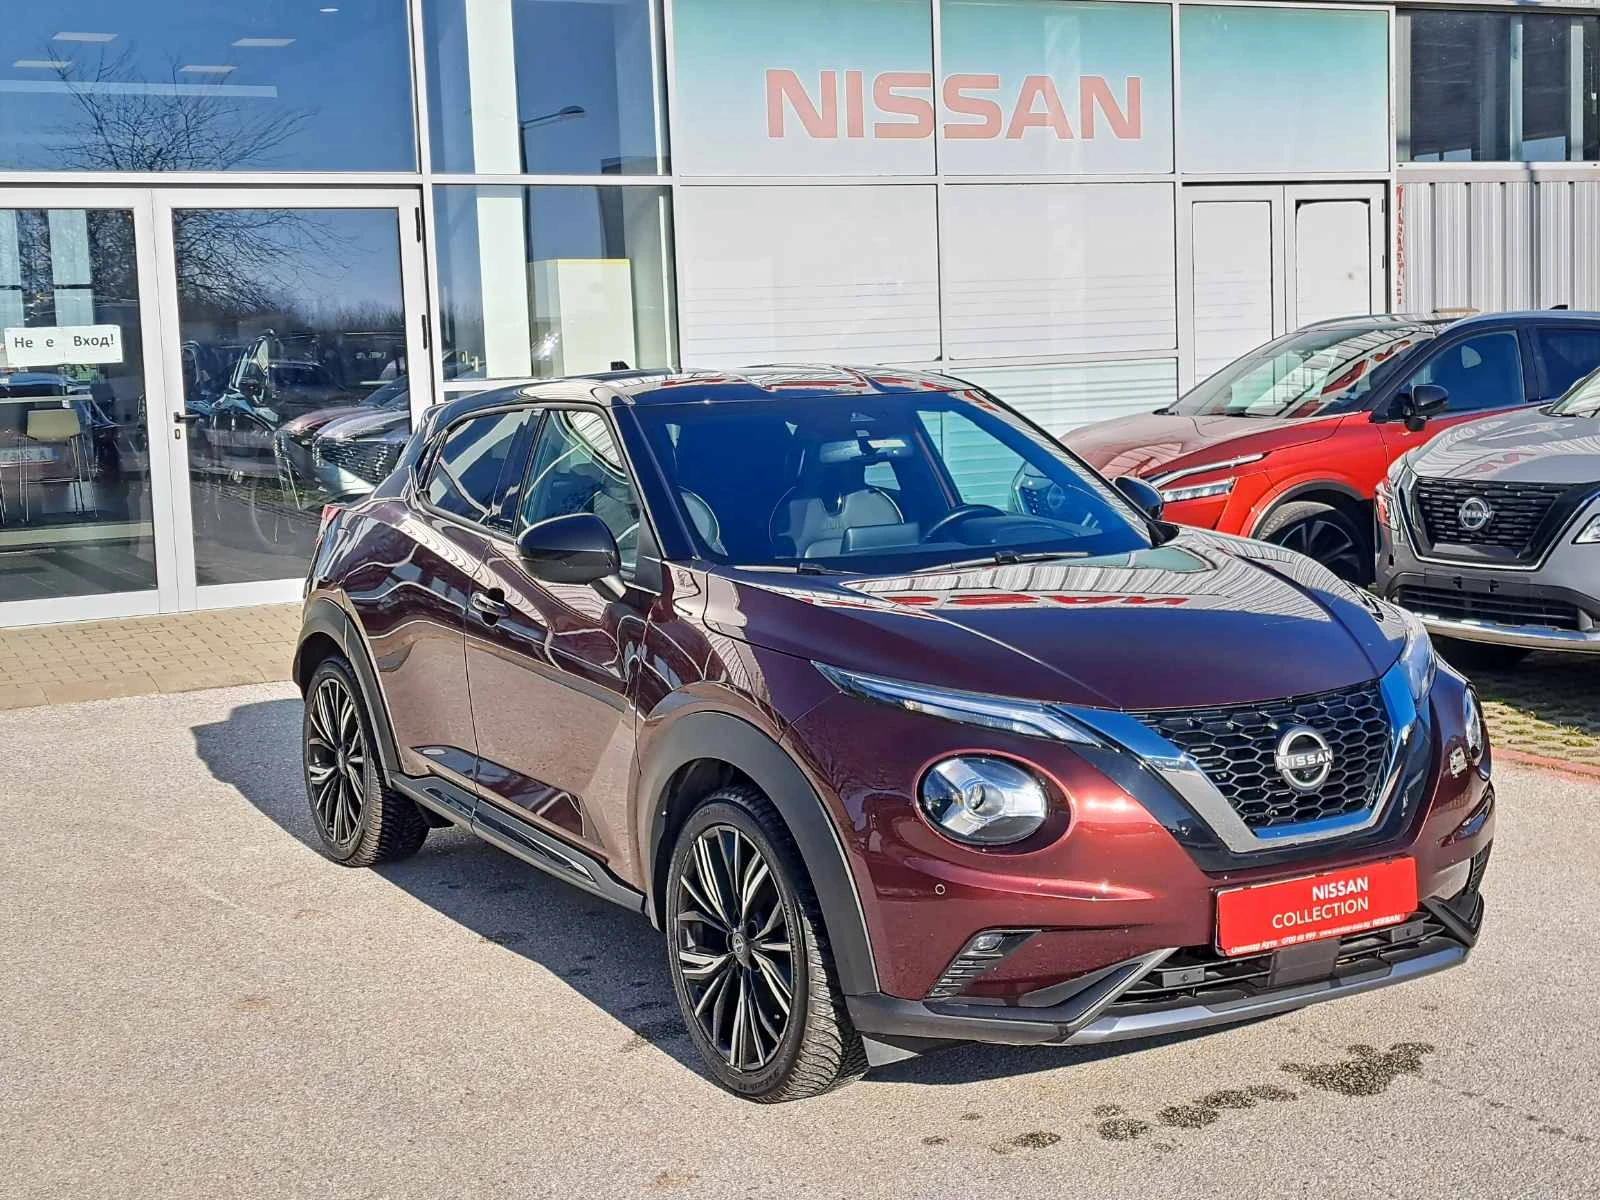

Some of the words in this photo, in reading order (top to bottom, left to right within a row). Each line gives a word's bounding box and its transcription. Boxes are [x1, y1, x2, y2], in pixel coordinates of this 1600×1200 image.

[765, 69, 1142, 139] NISSAN
[14, 337, 33, 348] Не
[46, 339, 55, 347] е
[73, 334, 114, 347] Вход!
[1275, 749, 1333, 770] NISSAN
[1312, 876, 1369, 901] NISSAN
[1272, 896, 1369, 929] COLLECTION
